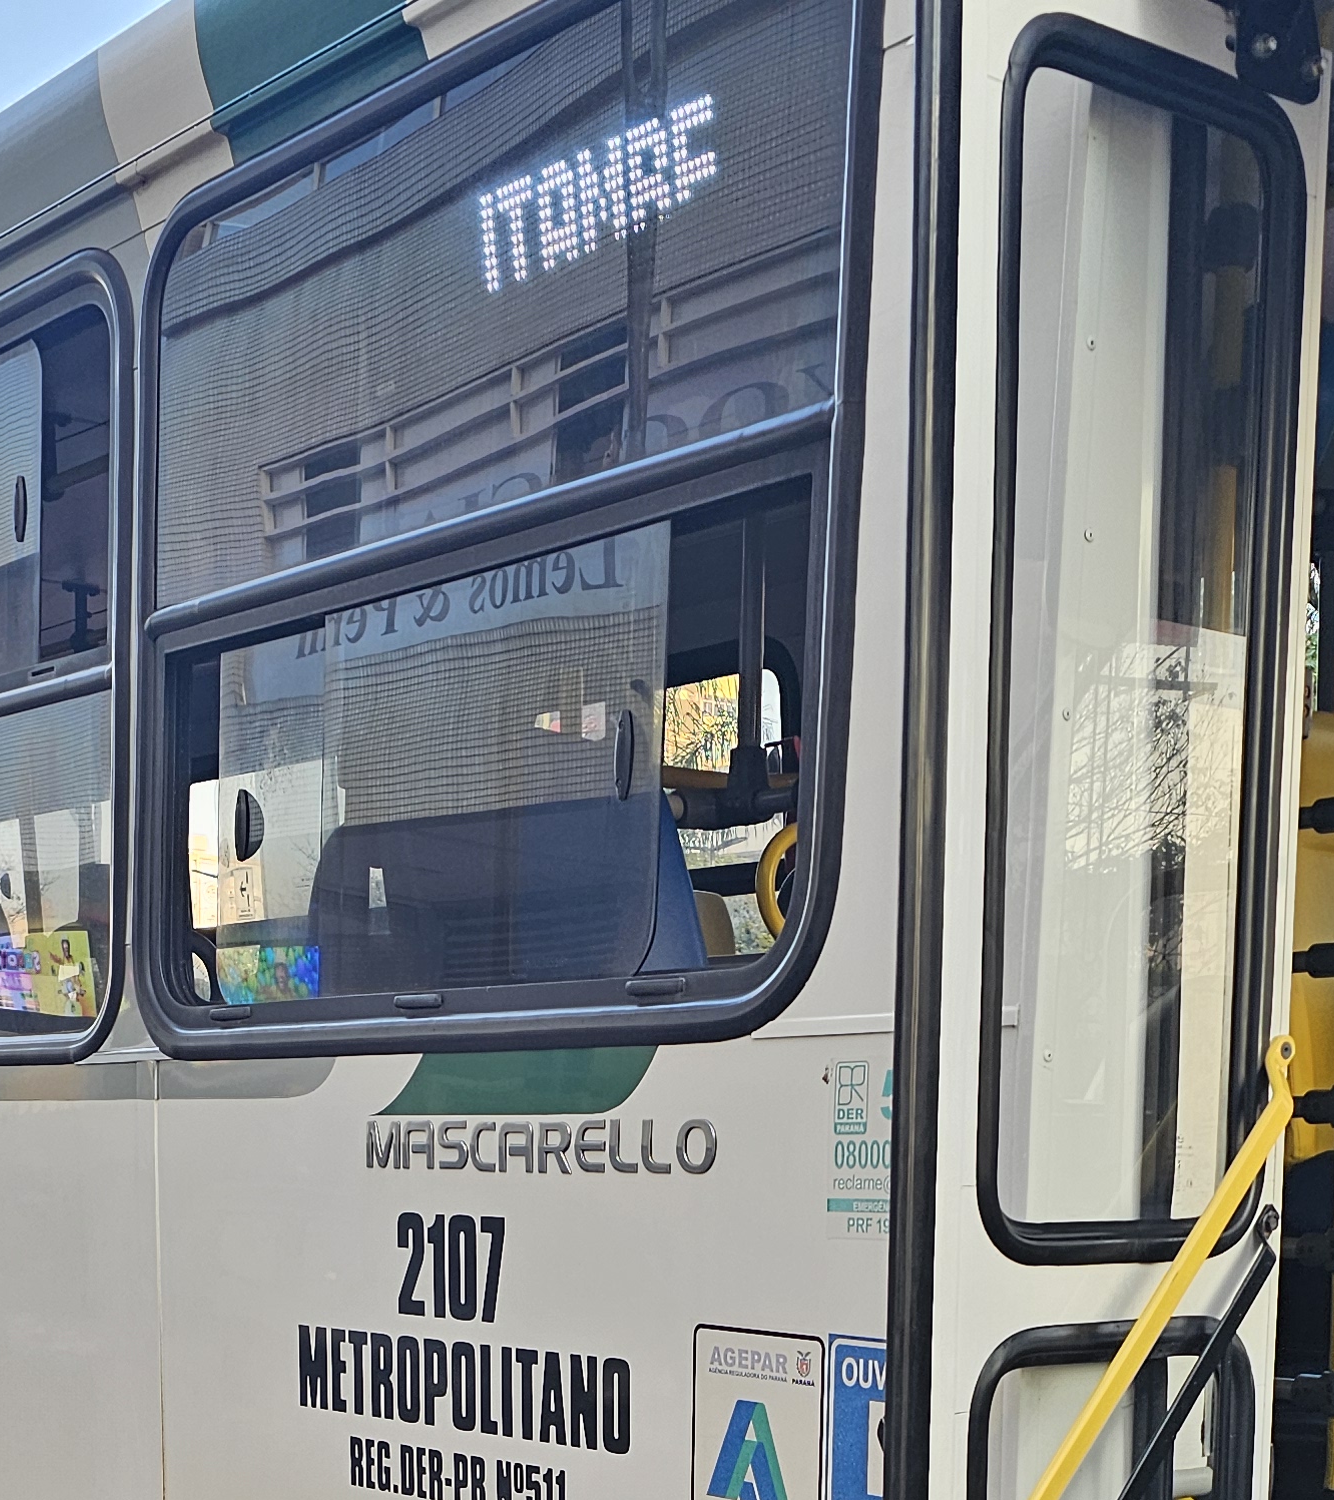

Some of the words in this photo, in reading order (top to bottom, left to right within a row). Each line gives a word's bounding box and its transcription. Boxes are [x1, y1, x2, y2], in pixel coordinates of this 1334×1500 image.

[837, 1108, 864, 1120] DER
[365, 1117, 718, 1175] MASCARELLO
[847, 1217, 873, 1233] PRF
[396, 1211, 506, 1324] 2107
[710, 1345, 788, 1375] AGEPAR
[297, 1324, 631, 1456] METROPOLITANO
